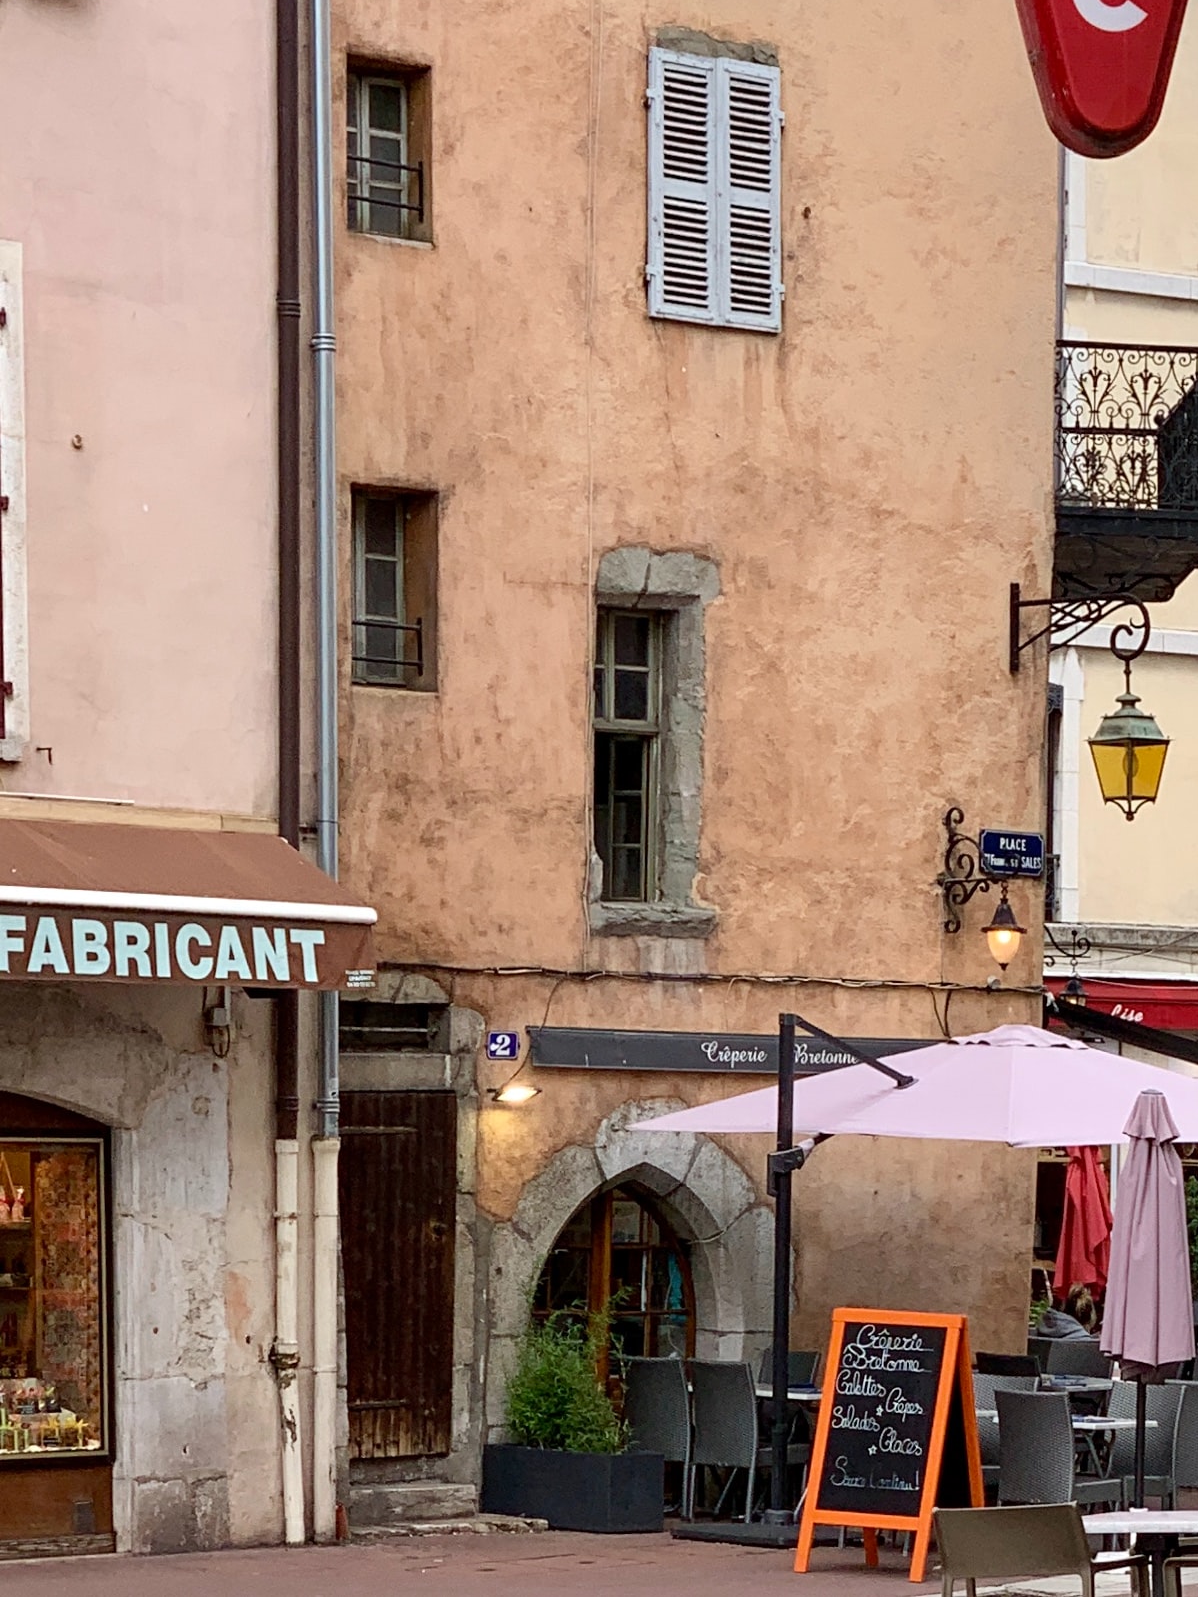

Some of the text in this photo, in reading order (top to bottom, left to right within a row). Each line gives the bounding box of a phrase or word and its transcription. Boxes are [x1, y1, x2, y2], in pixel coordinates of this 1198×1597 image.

[1000, 837, 1027, 851] PLACE
[1021, 856, 1042, 869] SALES
[0, 914, 325, 983] FABRICANT
[490, 1034, 511, 1056] 2
[701, 1040, 768, 1068] Crêperie
[857, 1324, 934, 1352] Crêperie
[842, 1343, 932, 1373] Bretonne
[832, 1404, 880, 1432] Salades
[885, 1387, 923, 1423] Crêpes
